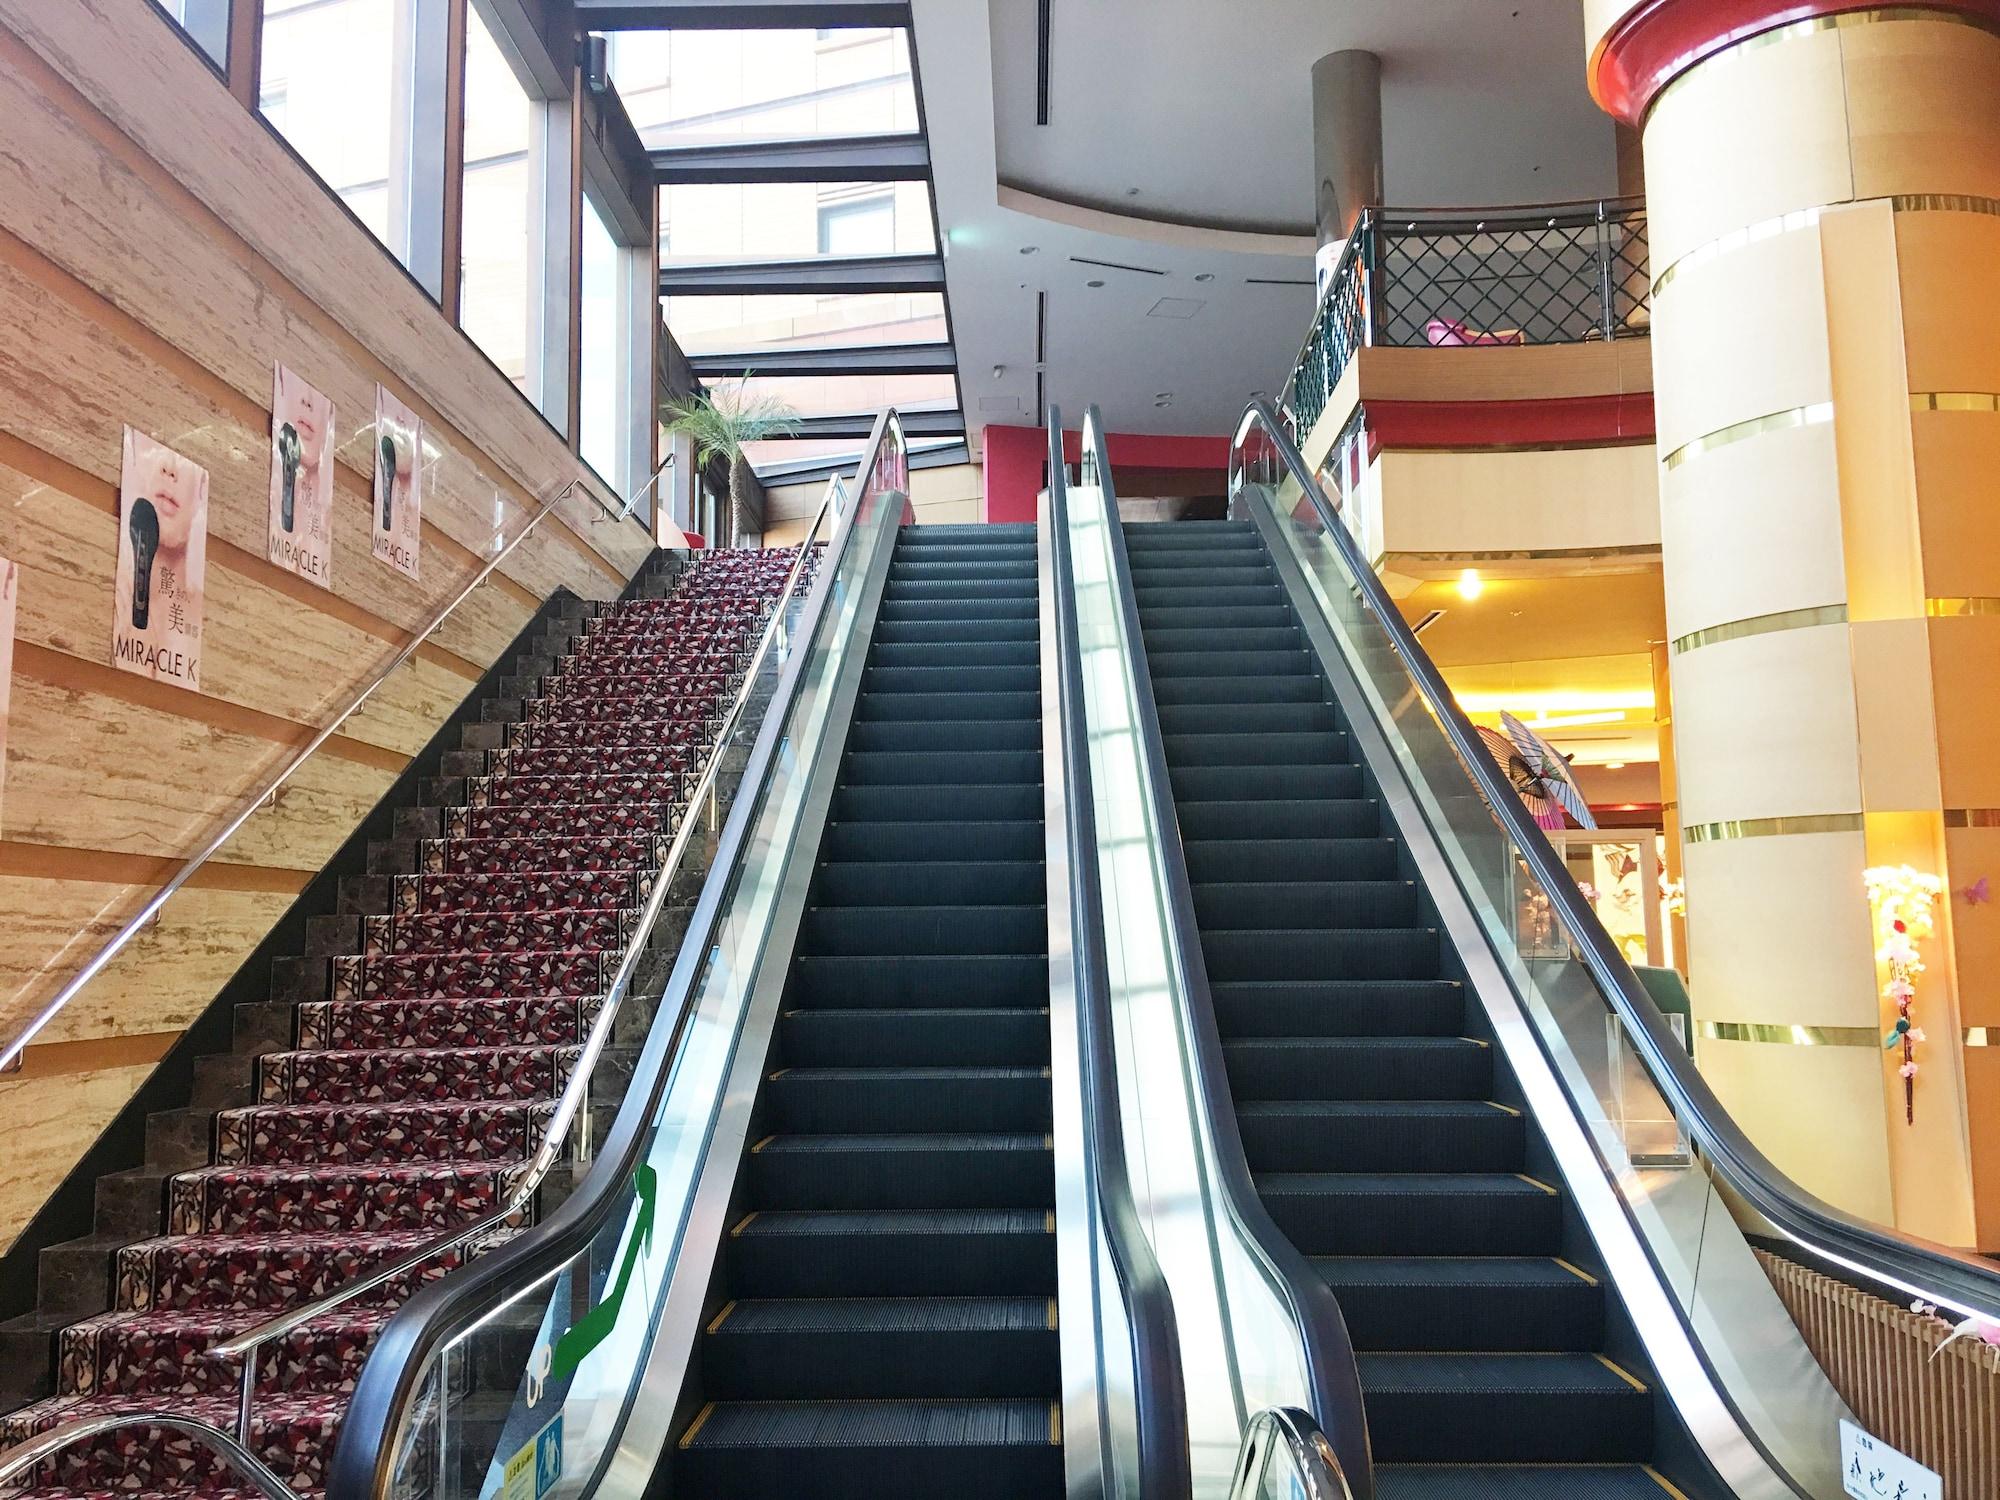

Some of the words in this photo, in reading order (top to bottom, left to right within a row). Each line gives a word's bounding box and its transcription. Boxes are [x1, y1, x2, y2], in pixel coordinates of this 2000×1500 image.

[270, 535, 318, 576] MIRACLE
[321, 560, 329, 581] K
[373, 533, 410, 570] MIRACLE
[412, 556, 418, 576] K
[115, 634, 183, 678] MIRACLE
[187, 657, 197, 682] K
